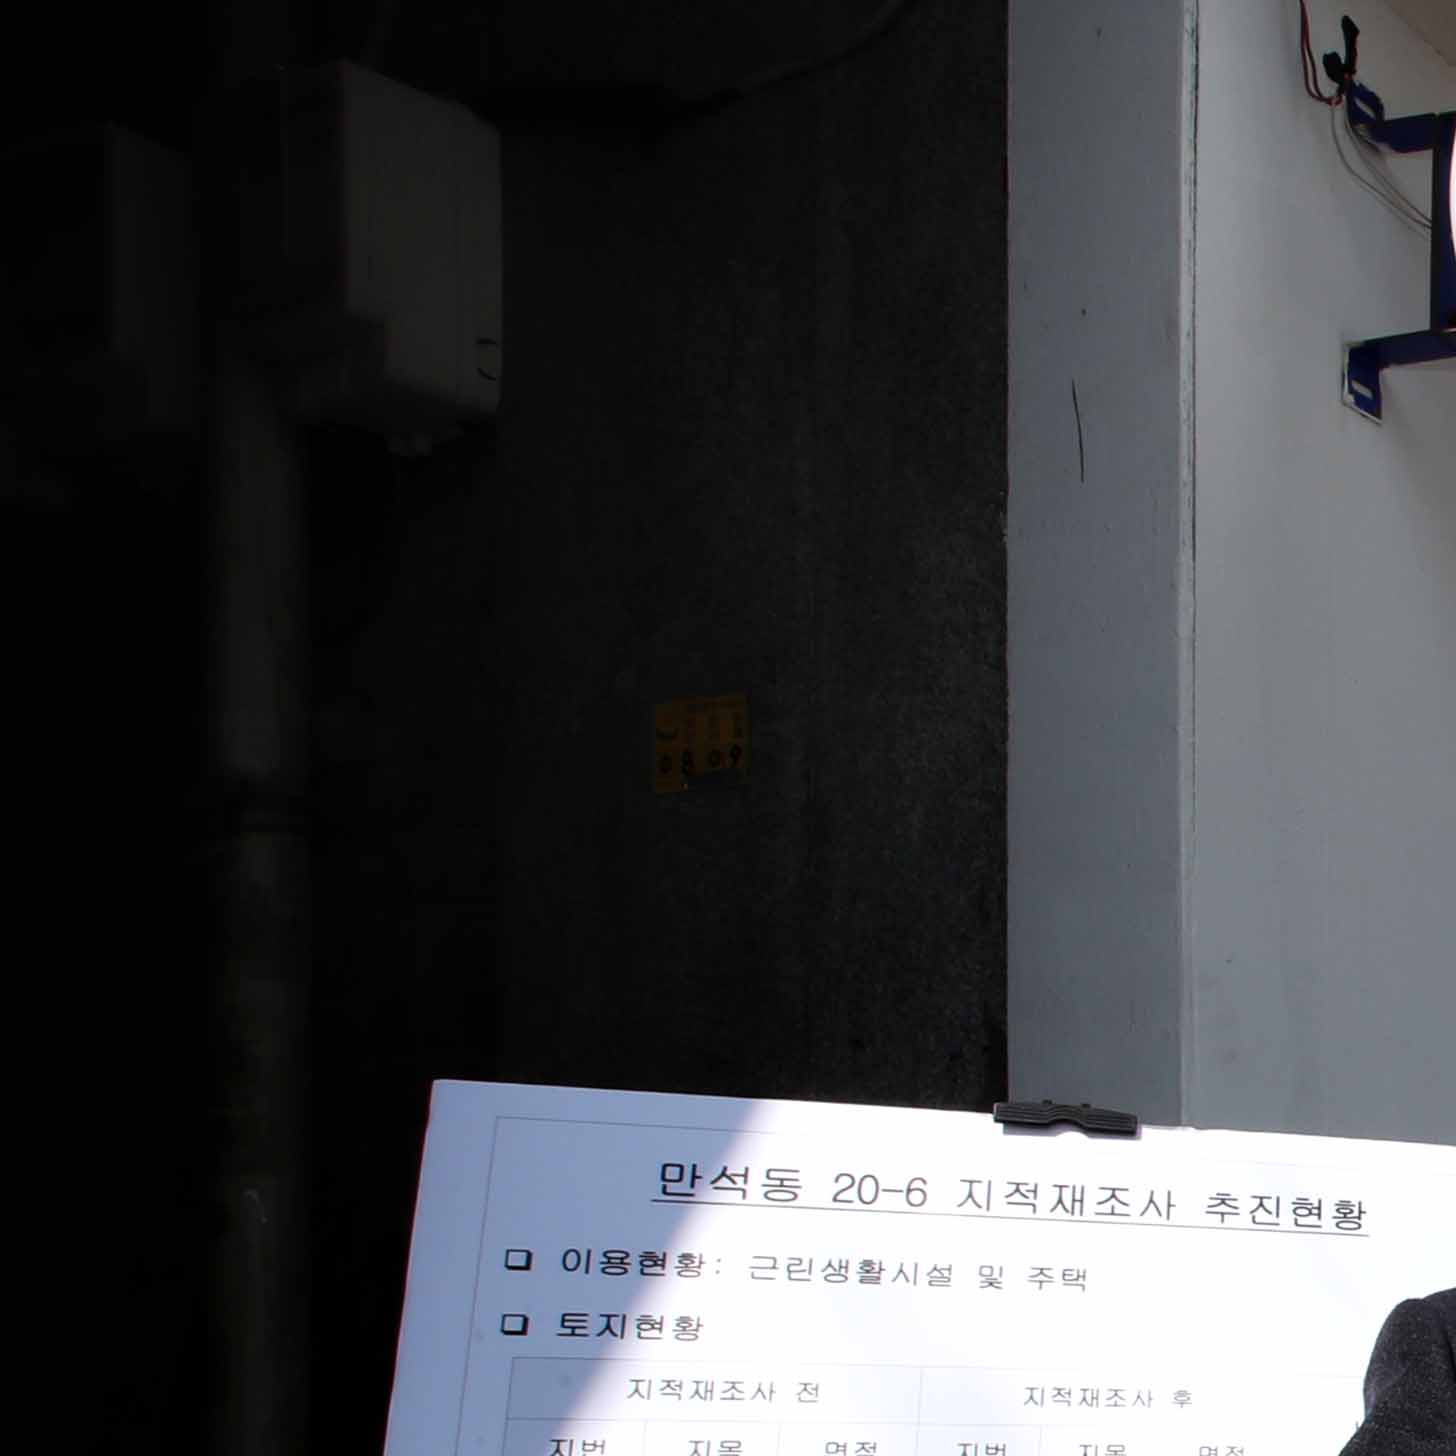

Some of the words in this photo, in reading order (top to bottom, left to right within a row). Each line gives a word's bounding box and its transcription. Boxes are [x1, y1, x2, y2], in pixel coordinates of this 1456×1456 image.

[657, 1162, 802, 1205] 만석동
[829, 1172, 928, 1211] 20-6
[956, 1179, 1177, 1224] 지적재조사
[1205, 1192, 1367, 1234] 추진현황
[561, 1248, 721, 1279] 이용현황:
[749, 1255, 953, 1288] 근린생활시설
[978, 1264, 1004, 1290] 및
[1027, 1267, 1087, 1292] 주택
[556, 1312, 704, 1342] 토지현황
[626, 1378, 777, 1402] 지적재조사
[796, 1382, 819, 1404] 전
[1023, 1386, 1153, 1409] 지적재조사
[1172, 1389, 1193, 1409] 후
